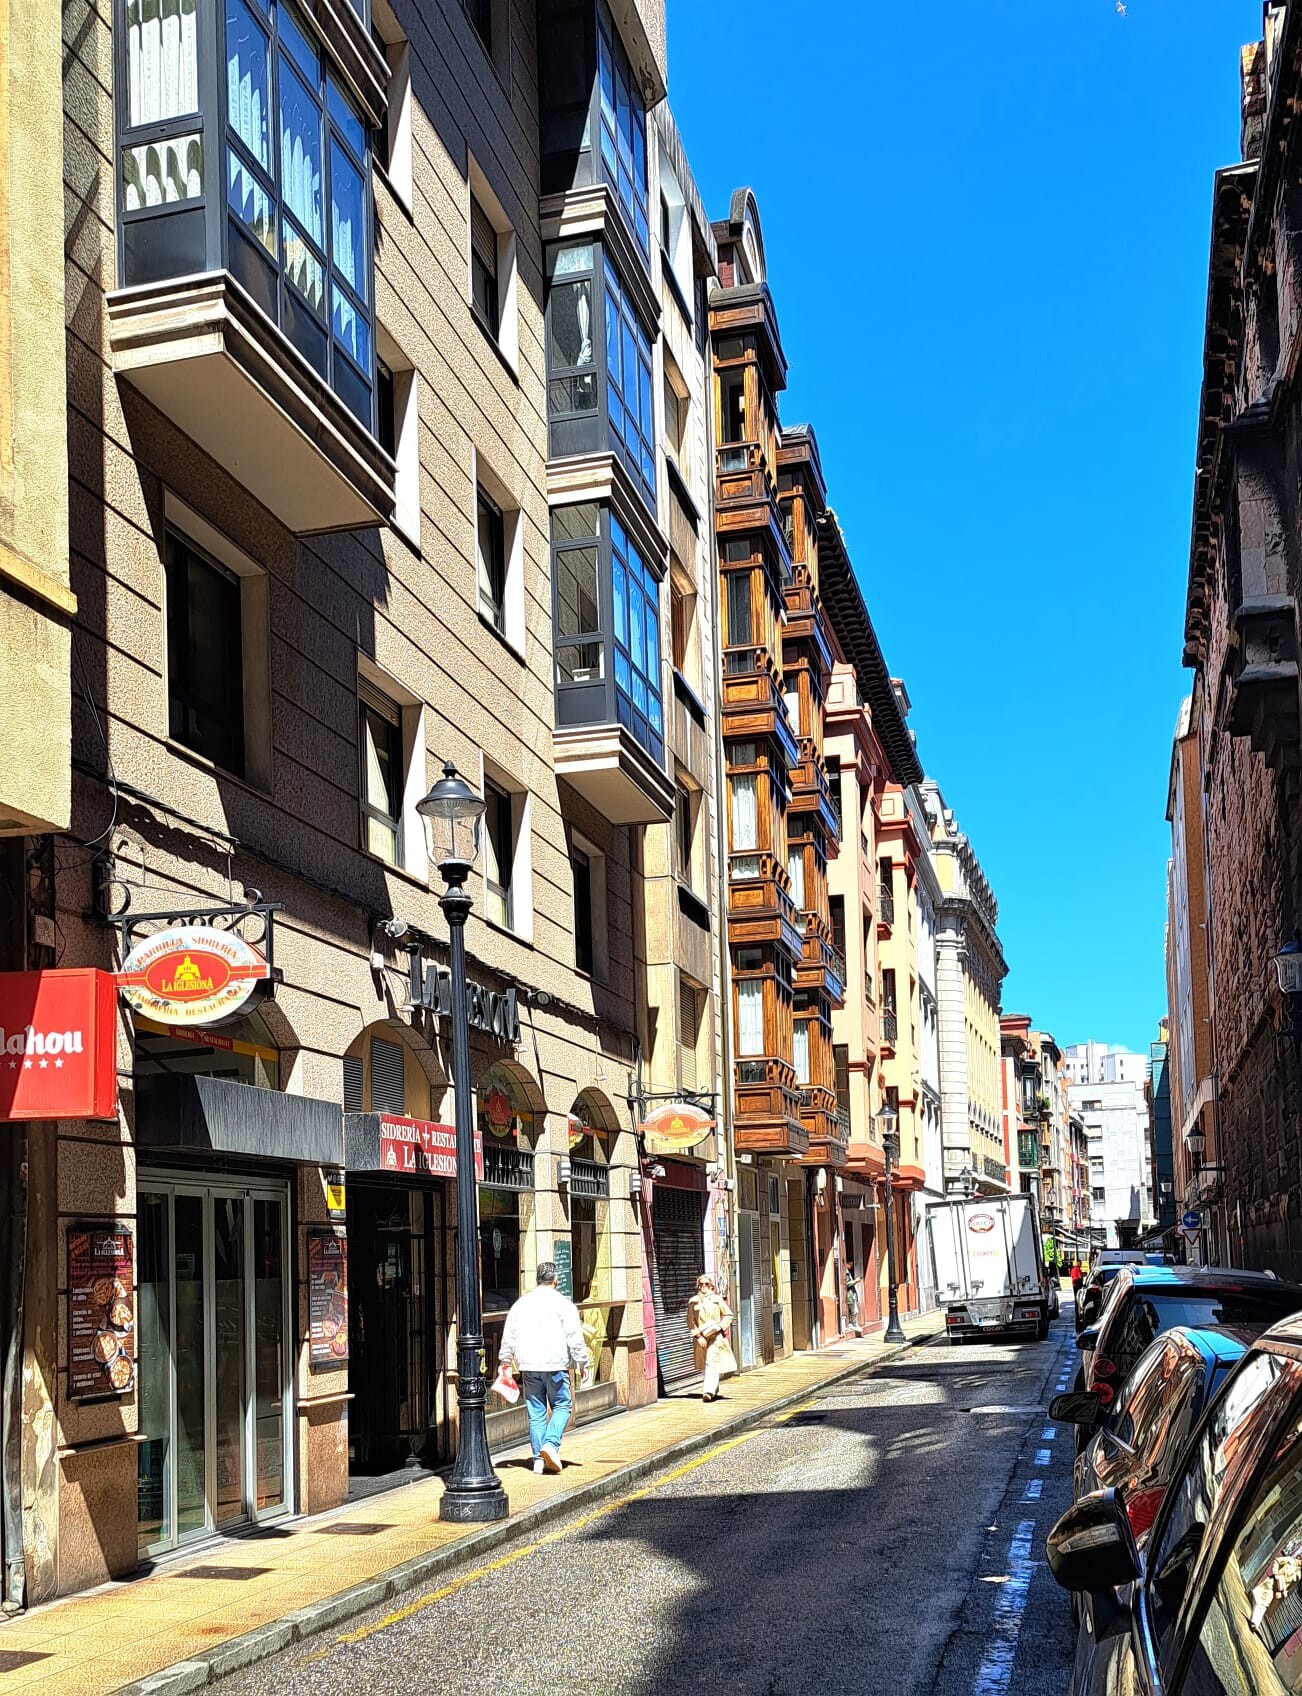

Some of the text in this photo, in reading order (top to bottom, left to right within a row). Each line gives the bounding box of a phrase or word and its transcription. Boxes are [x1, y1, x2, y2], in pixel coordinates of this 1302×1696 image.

[136, 937, 184, 965] PARRILLA
[162, 976, 213, 993] LA IGLESIONA
[381, 1122, 481, 1153] SIDRERÍA RESTATE
[403, 1145, 416, 1169] LA
